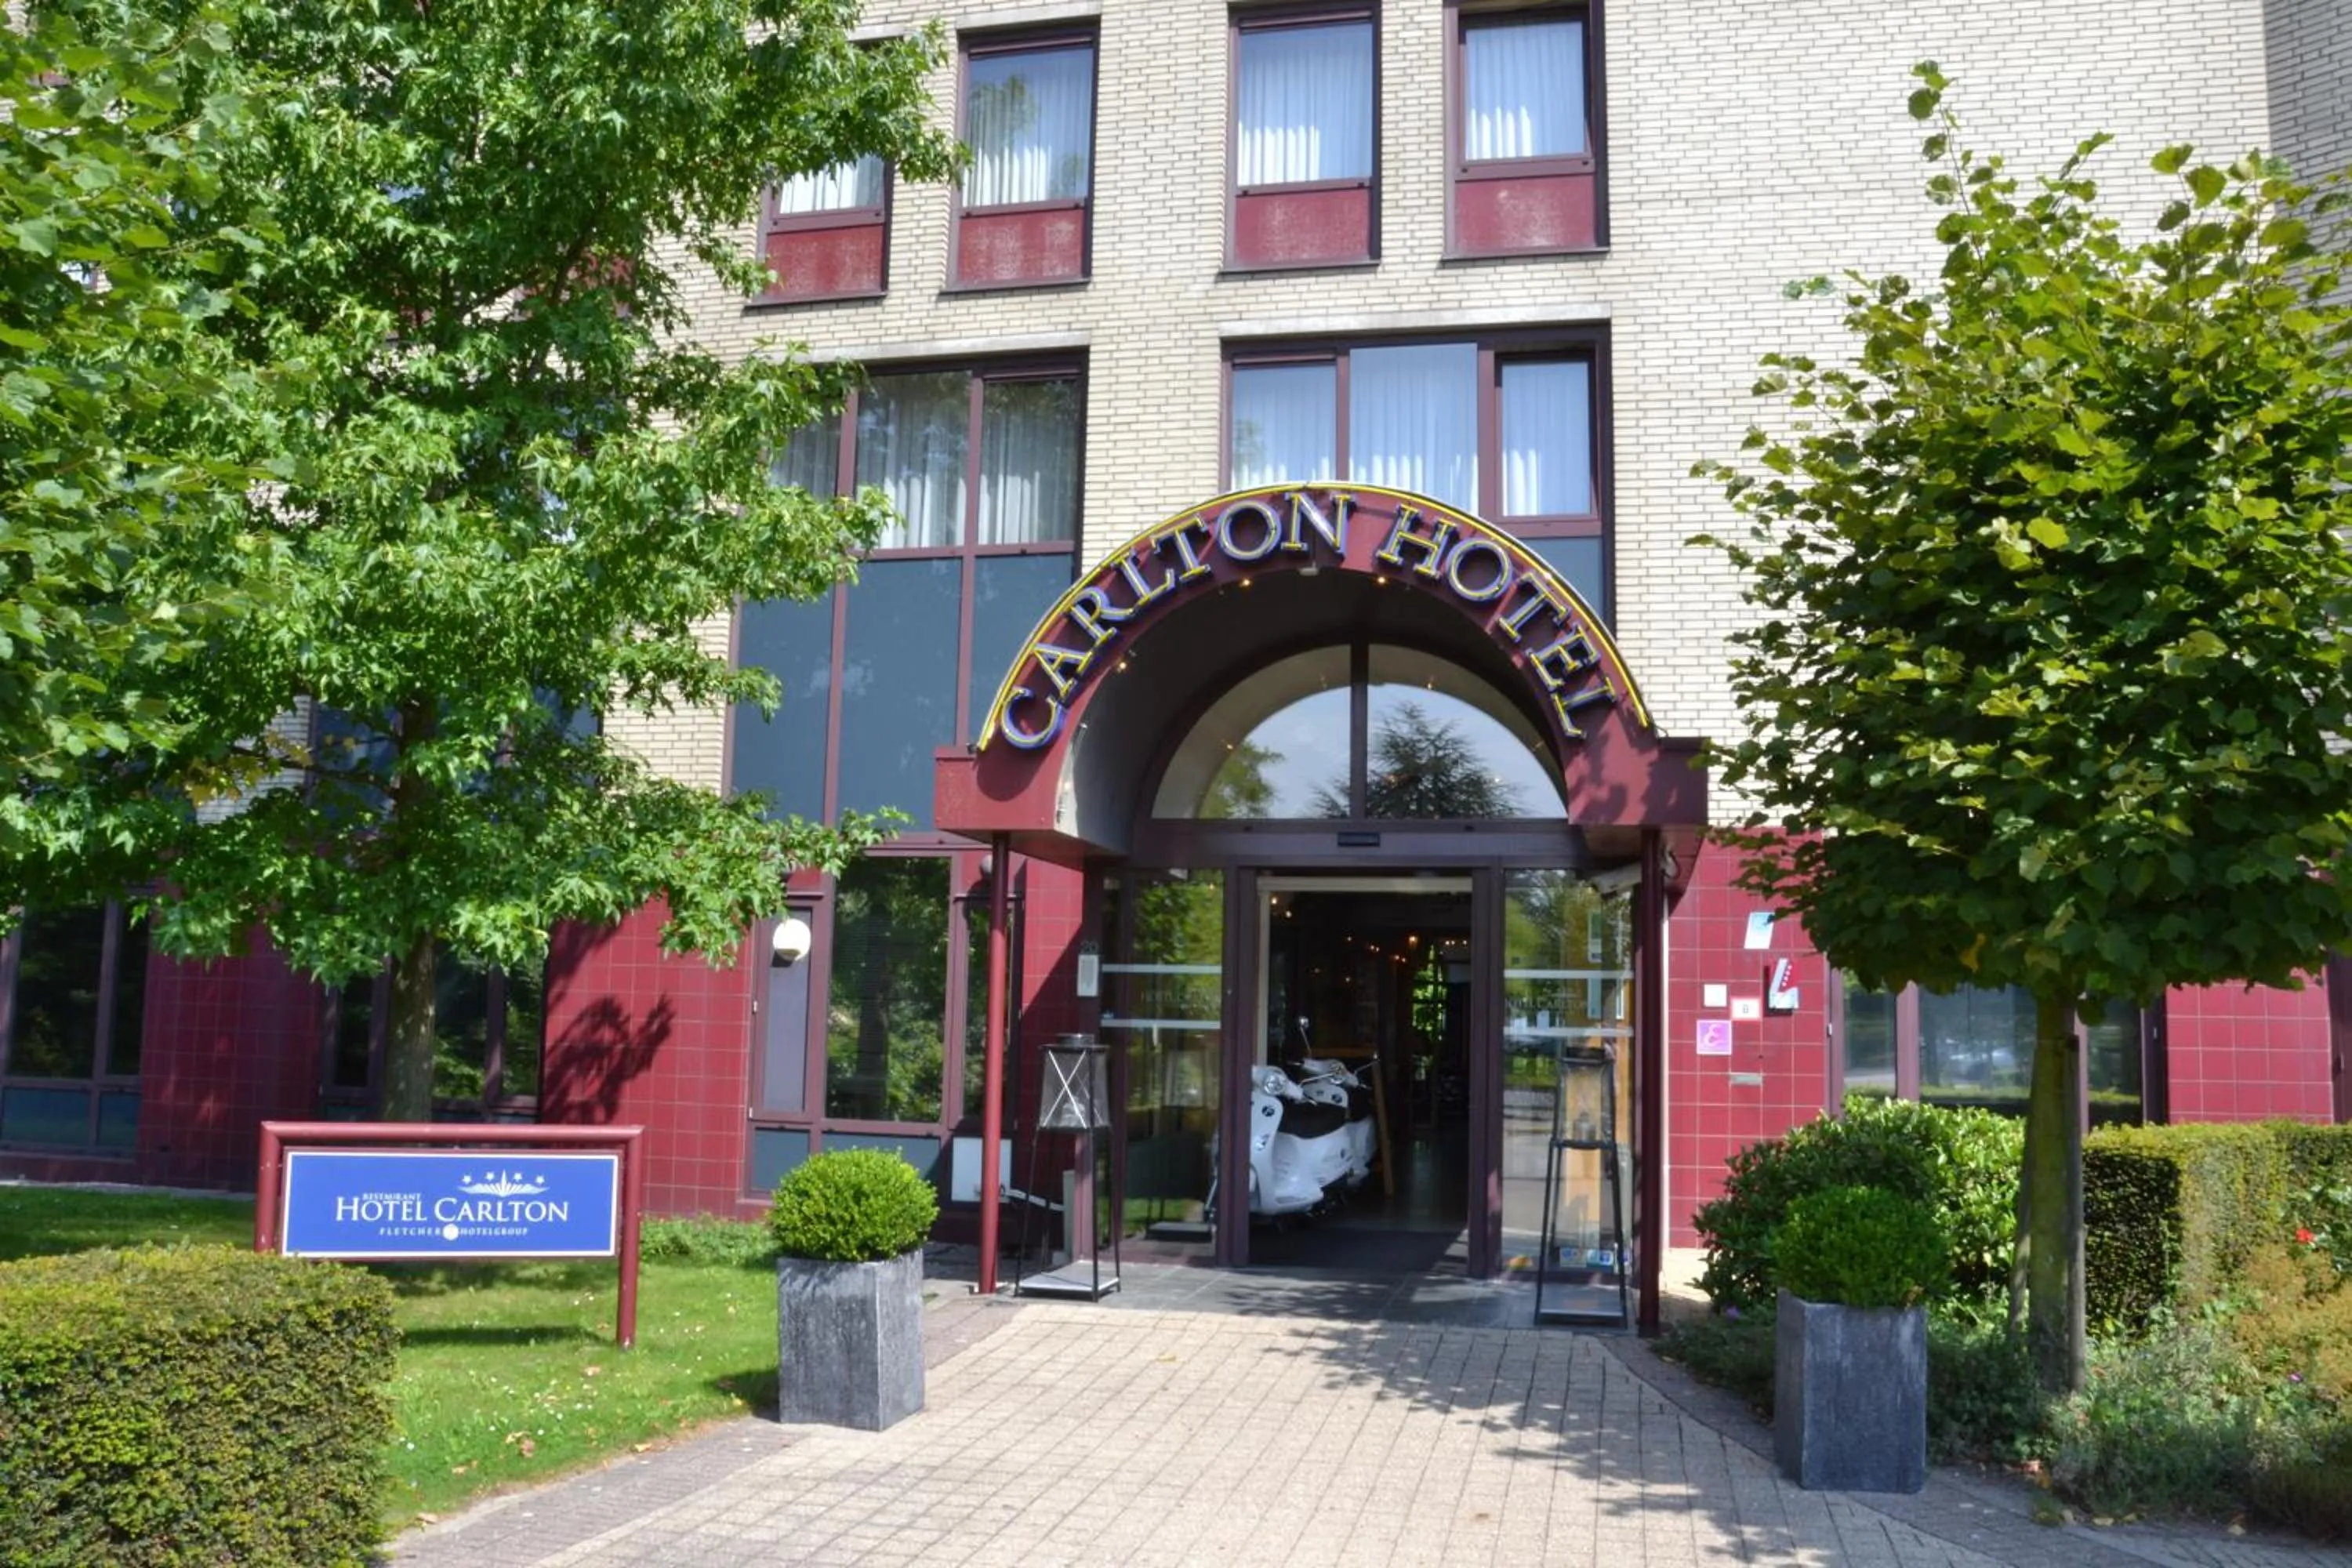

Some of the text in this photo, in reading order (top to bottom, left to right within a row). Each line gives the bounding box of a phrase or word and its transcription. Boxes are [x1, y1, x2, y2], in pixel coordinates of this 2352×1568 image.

[1000, 491, 1618, 750] CARLTON HOTEL
[362, 1192, 422, 1201] RESTAURANT
[336, 1196, 569, 1221] HOTEL CARLTON
[379, 1227, 441, 1236] FLETCHER
